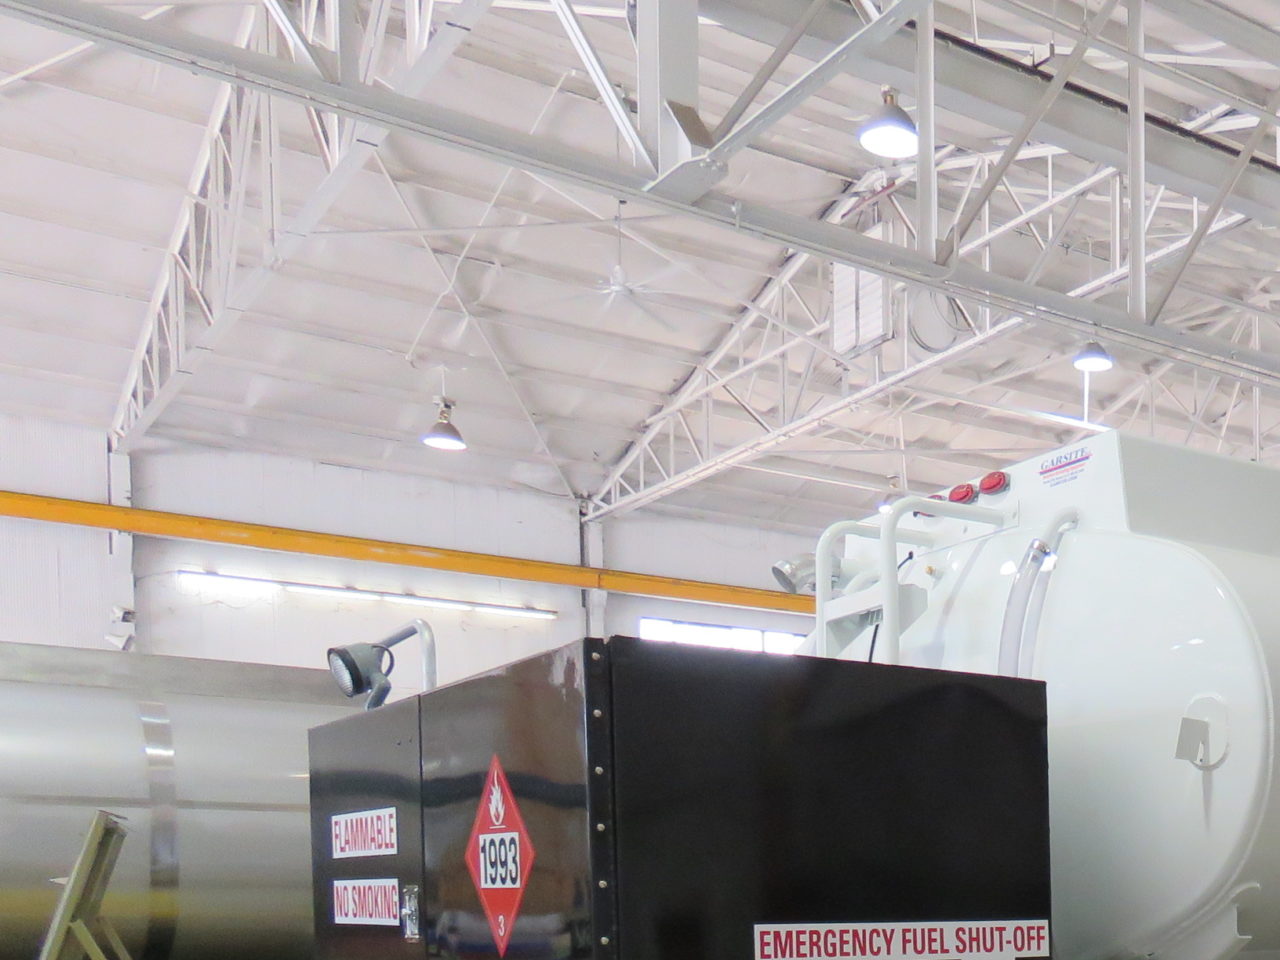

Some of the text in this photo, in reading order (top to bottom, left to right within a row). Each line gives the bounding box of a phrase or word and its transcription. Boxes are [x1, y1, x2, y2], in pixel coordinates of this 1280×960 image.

[1040, 447, 1089, 470] GARSITE
[334, 813, 395, 853] FLAMMABLE
[480, 836, 519, 885] 1993
[335, 884, 398, 920] NO SMOKING
[498, 915, 505, 937] 3
[759, 925, 1046, 959] EMERGENCY FUEL SHUT-OFF
